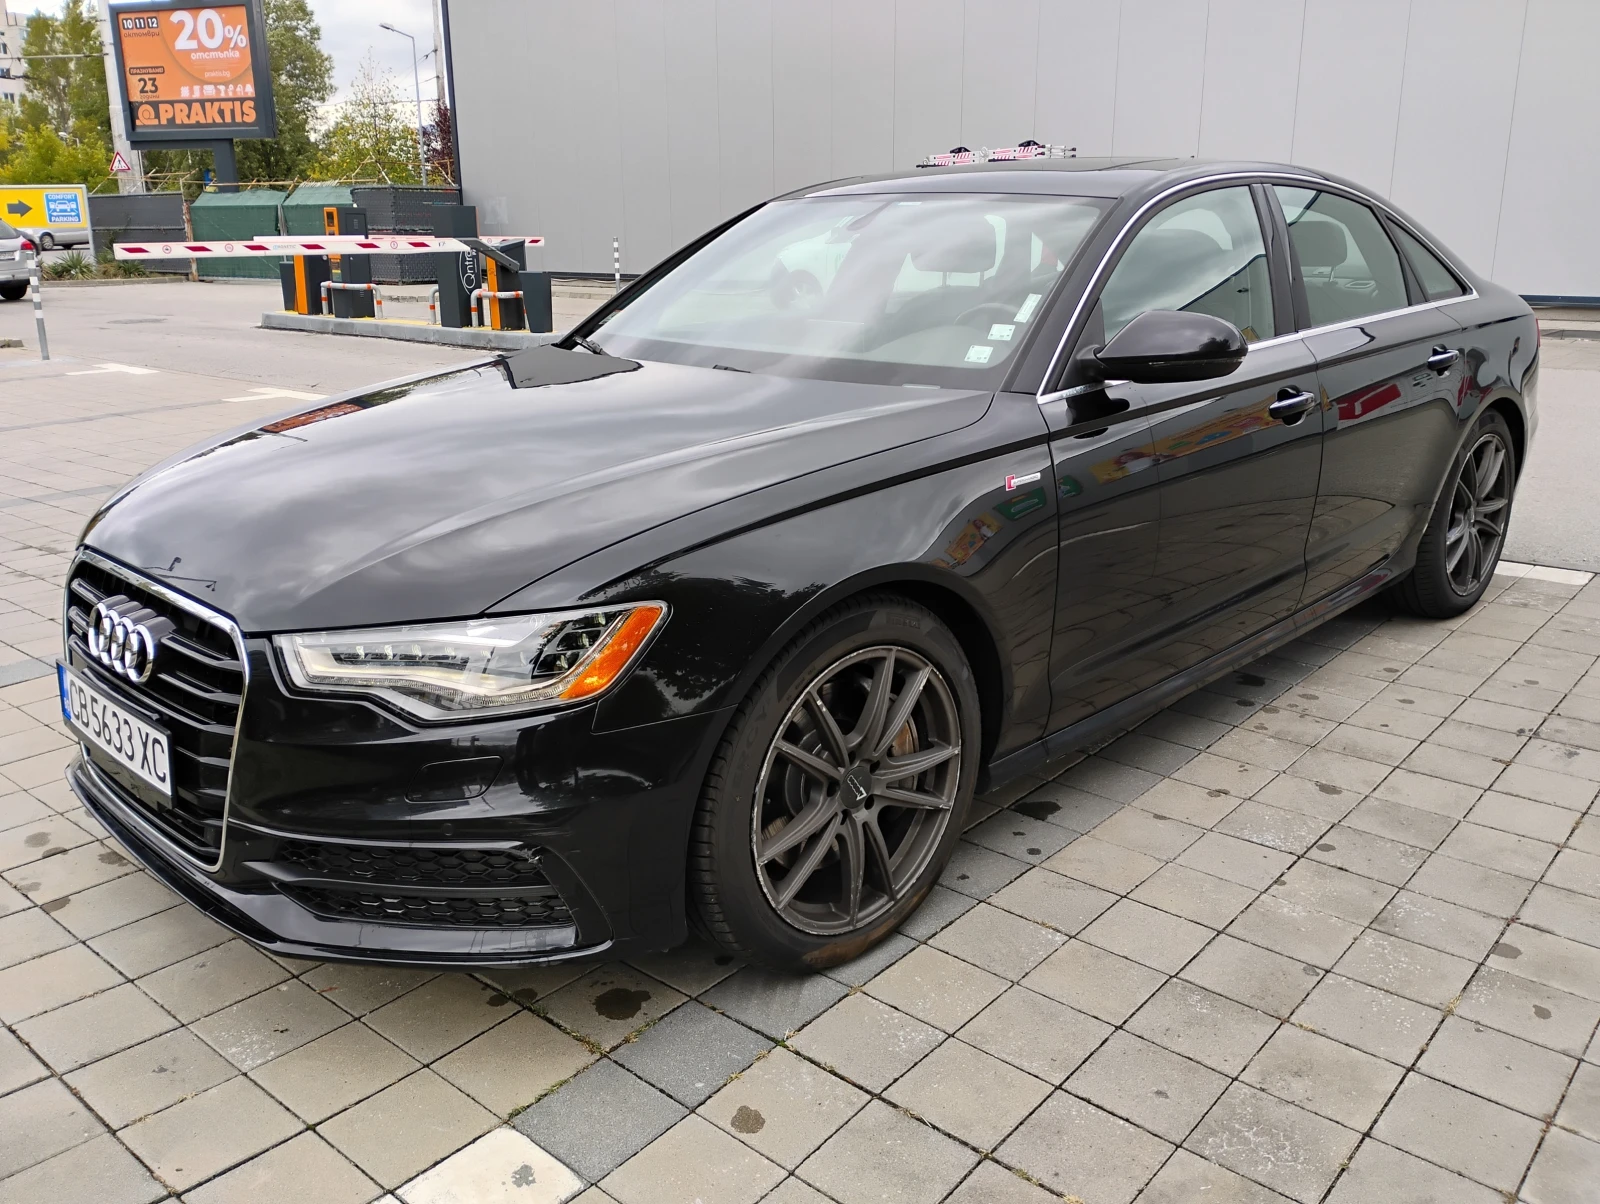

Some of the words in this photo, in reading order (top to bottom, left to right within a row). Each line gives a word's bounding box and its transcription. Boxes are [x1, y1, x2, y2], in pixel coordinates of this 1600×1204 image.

[123, 18, 133, 29] 10
[135, 18, 145, 28] 11
[148, 17, 158, 28] 12
[169, 8, 247, 50] 20%
[123, 30, 160, 38] октомври
[190, 49, 240, 61] отстъпка
[137, 77, 159, 94] 23
[158, 100, 257, 125] PRAKTIS
